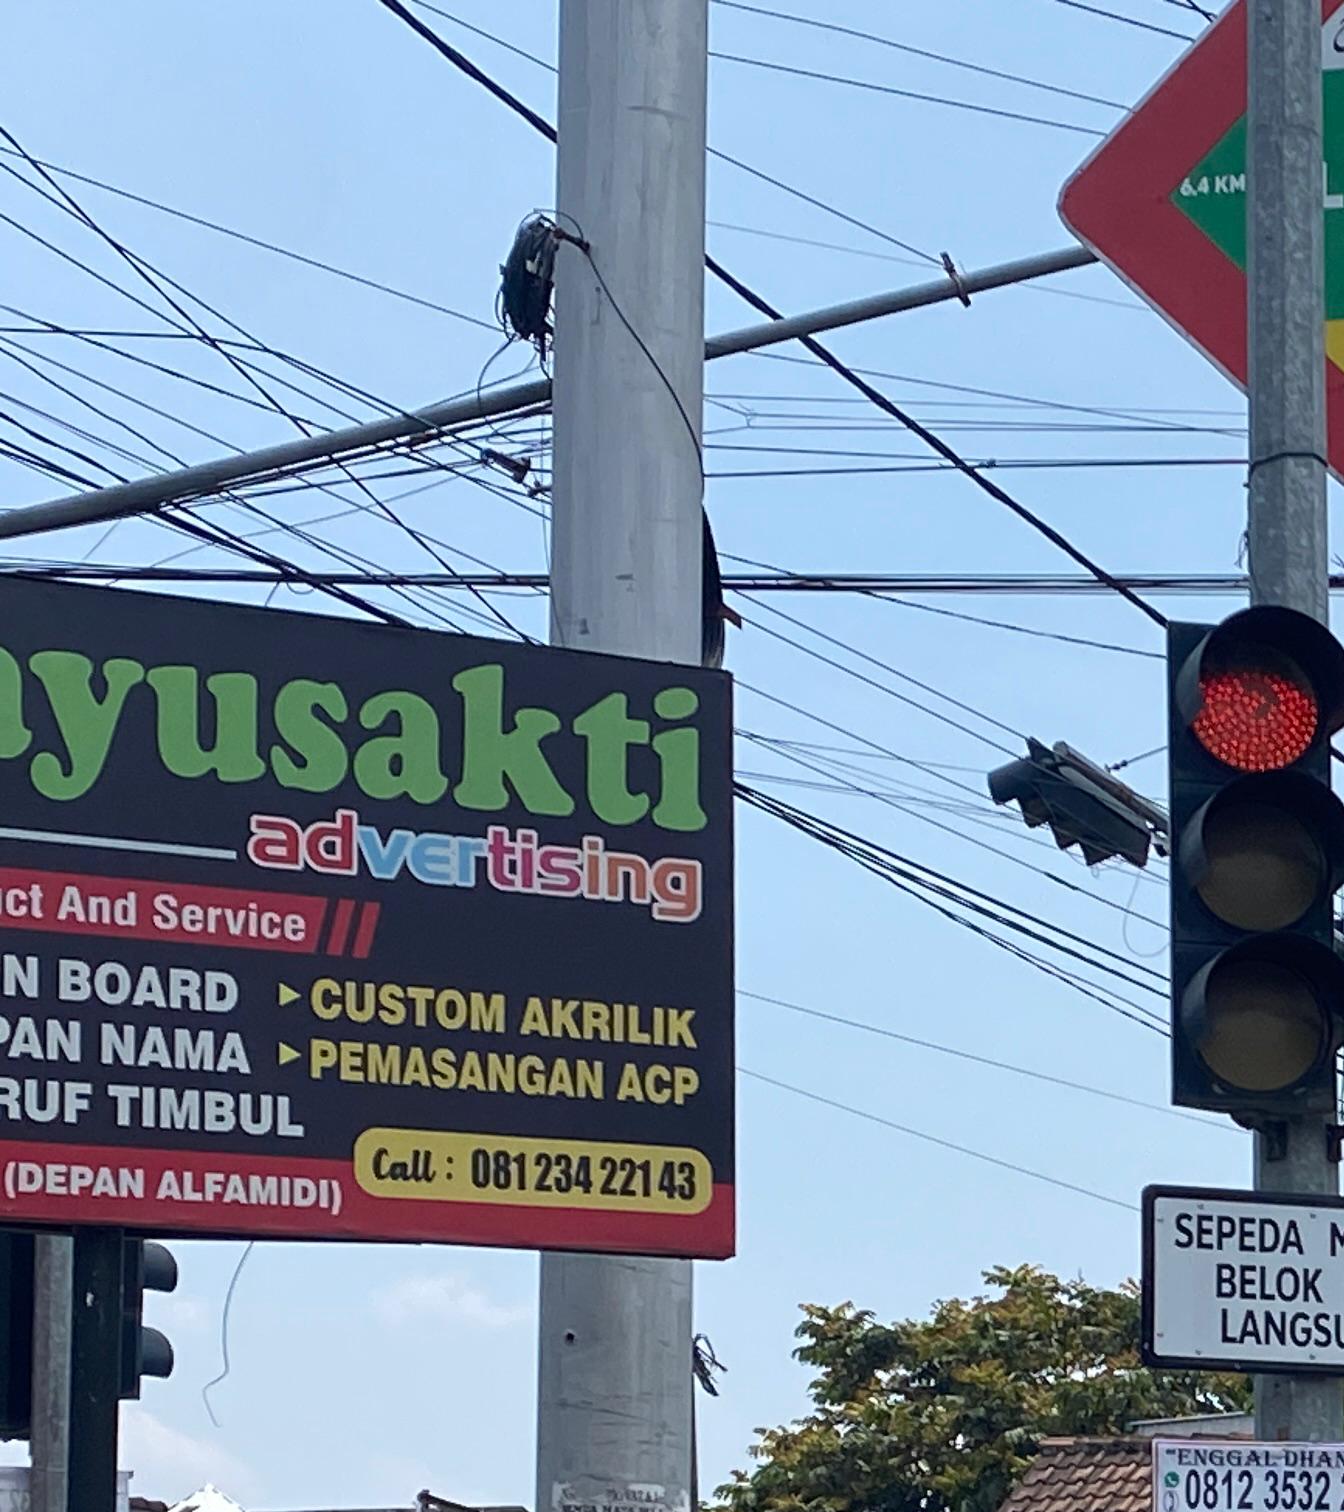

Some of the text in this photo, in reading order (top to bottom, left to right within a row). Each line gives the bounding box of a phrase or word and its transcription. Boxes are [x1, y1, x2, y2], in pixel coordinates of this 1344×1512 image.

[1179, 172, 1246, 197] 6.4 KM
[248, 809, 701, 922] advertising
[0, 883, 306, 942] ct And Service
[58, 958, 239, 1014] BOARD
[311, 978, 697, 1049] CUSTOM AKRILIK
[101, 1024, 251, 1075] NAMA
[311, 1040, 699, 1105] PEMASANGAN ACP
[107, 1088, 305, 1138] TIMBUL
[4, 1160, 343, 1215] (DEPAN ALFAMIDI)
[372, 1147, 436, 1183] Call
[1174, 1213, 1304, 1256] SEPEDA
[1216, 1263, 1324, 1304] BELOK
[1185, 1469, 1254, 1510] 0812
[1263, 1470, 1330, 1511] 3532
